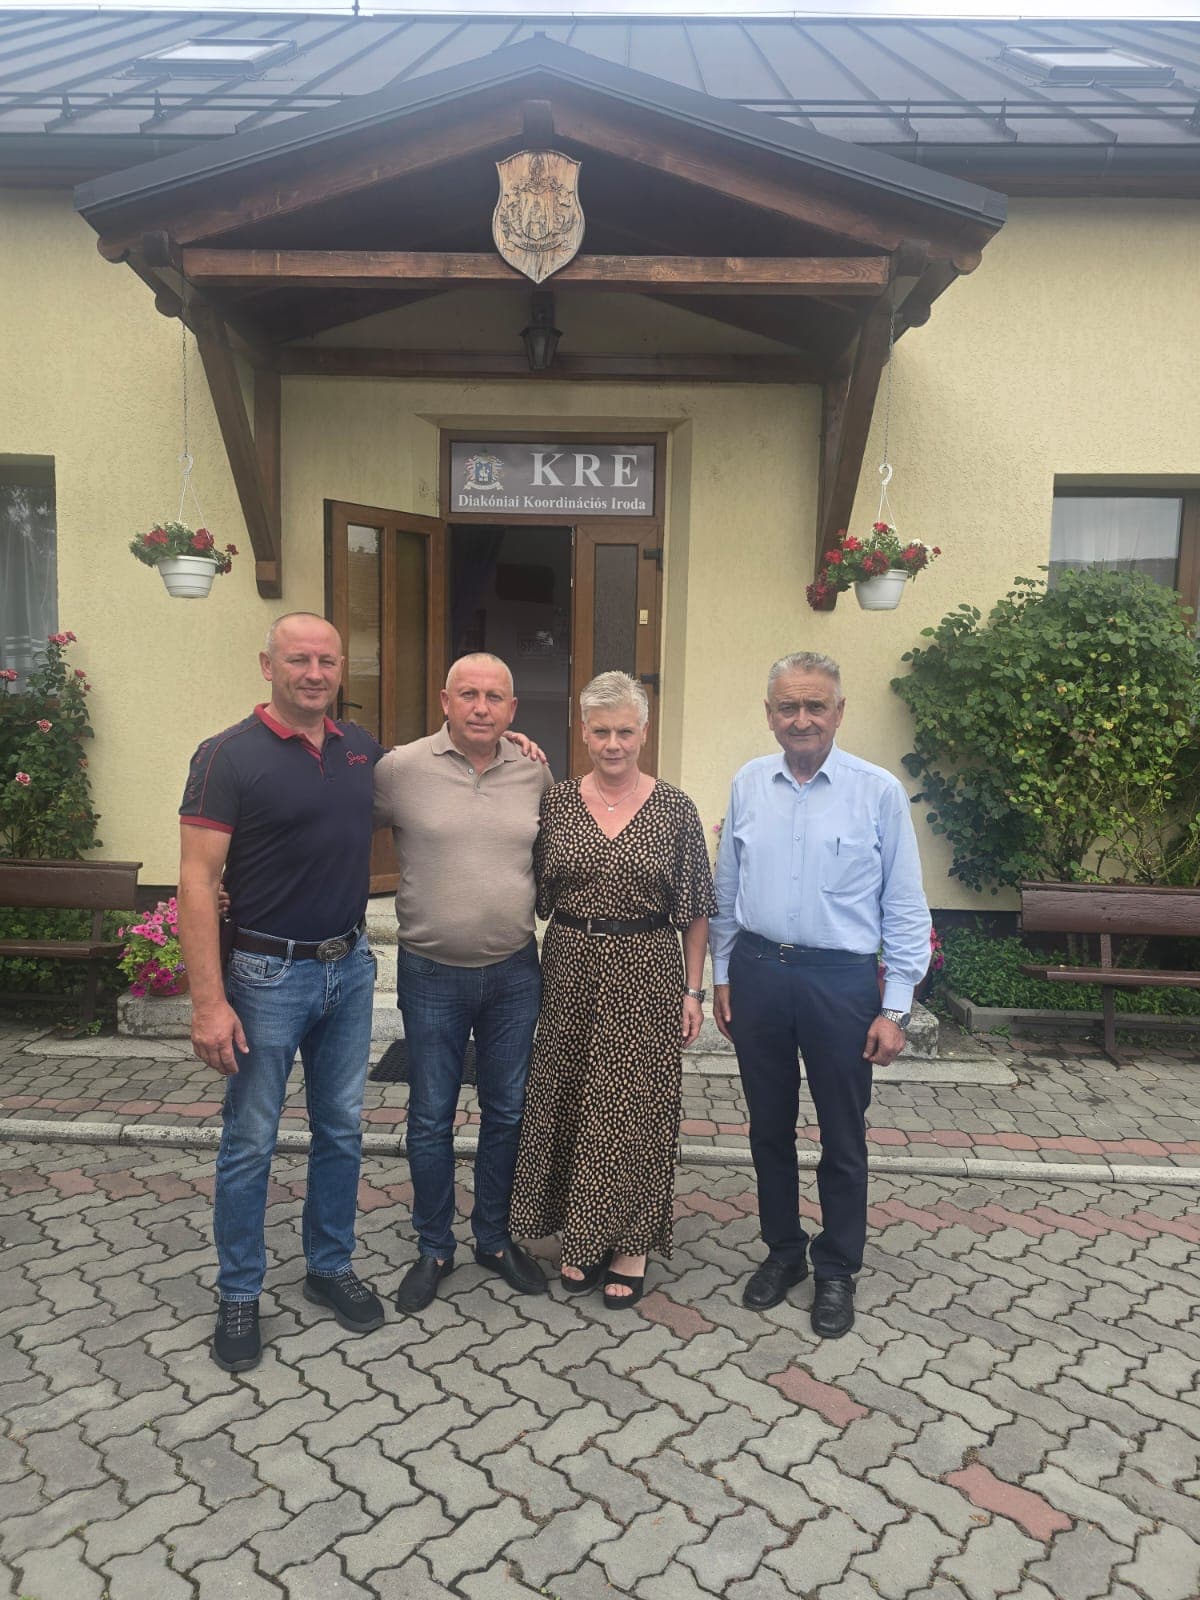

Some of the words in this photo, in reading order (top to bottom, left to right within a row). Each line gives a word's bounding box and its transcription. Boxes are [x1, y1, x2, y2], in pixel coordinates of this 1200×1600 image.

[529, 452, 639, 487] KRE
[457, 494, 519, 507] Diakóniai
[523, 496, 608, 509] Koordinációs
[612, 497, 646, 510] Iroda
